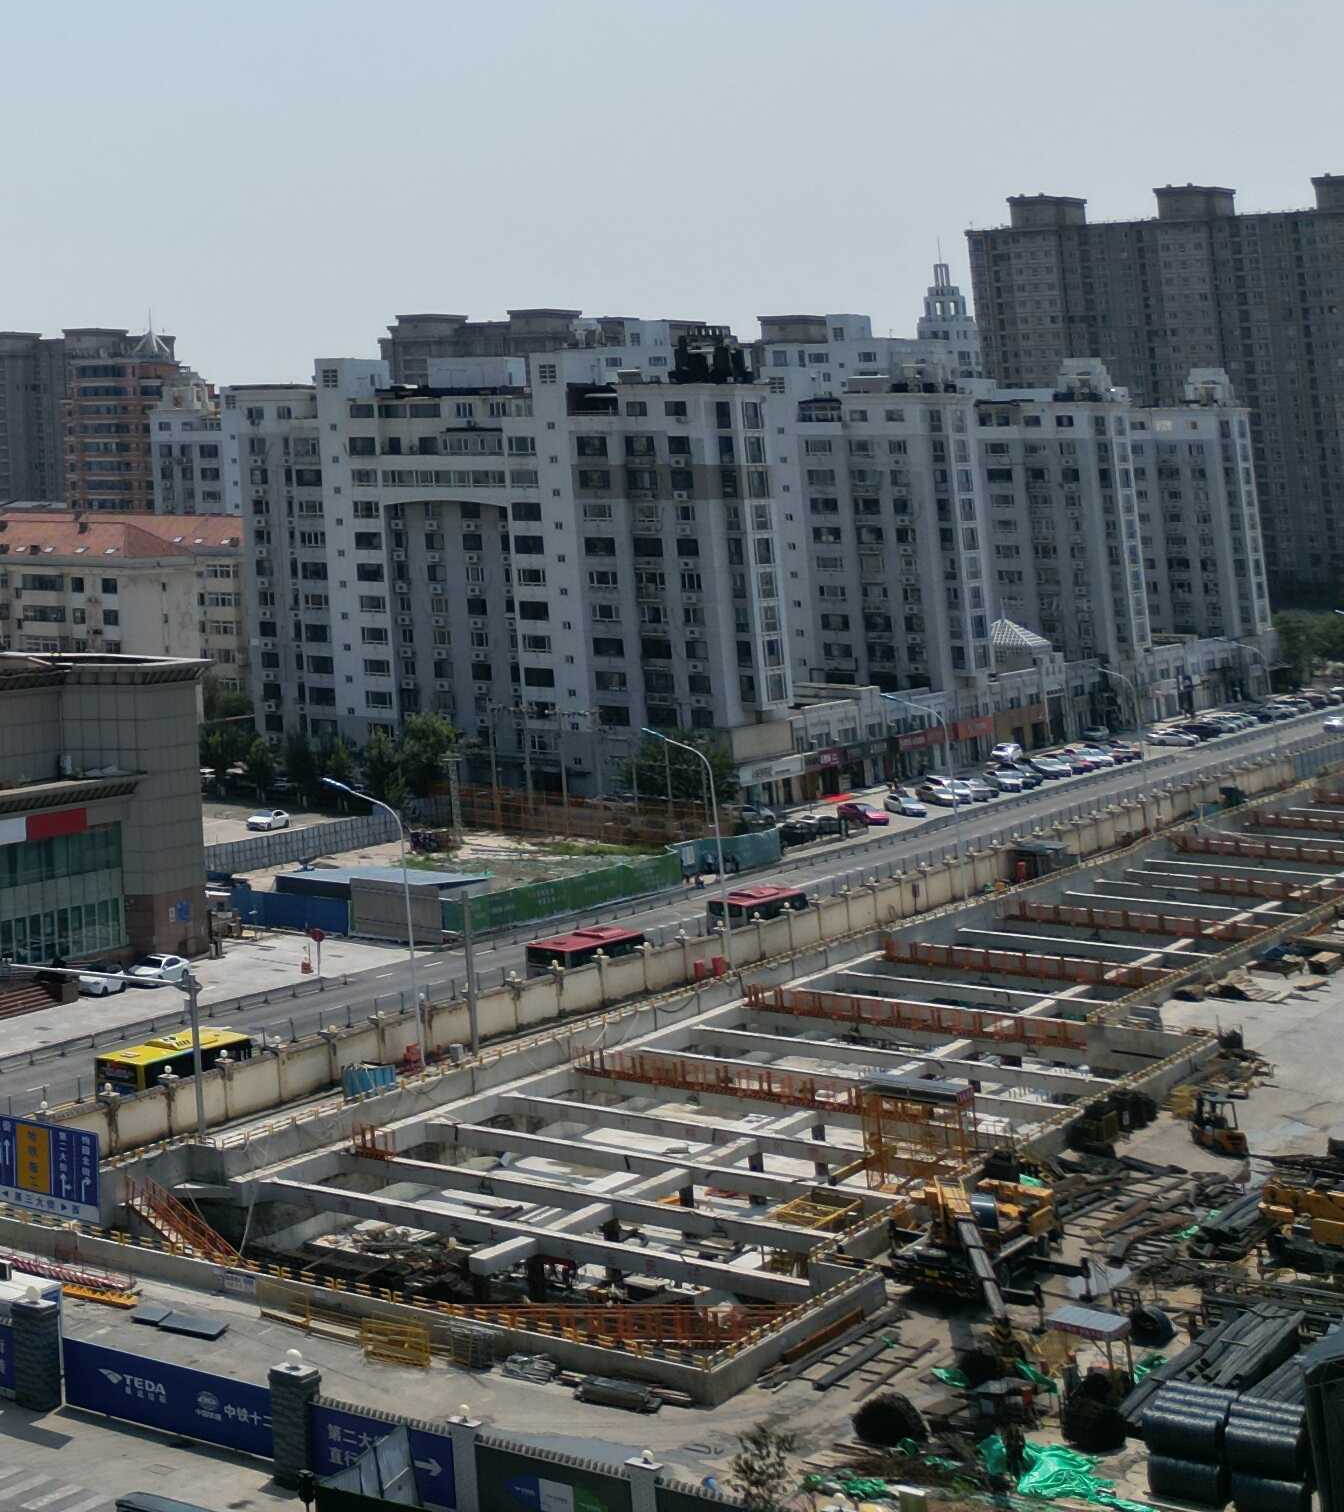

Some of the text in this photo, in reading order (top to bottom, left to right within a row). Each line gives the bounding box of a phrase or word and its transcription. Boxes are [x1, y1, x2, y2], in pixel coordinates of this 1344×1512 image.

[58, 1131, 68, 1172] 第二大街
[123, 1374, 166, 1394] TEDA
[328, 1424, 384, 1448] 第二大
